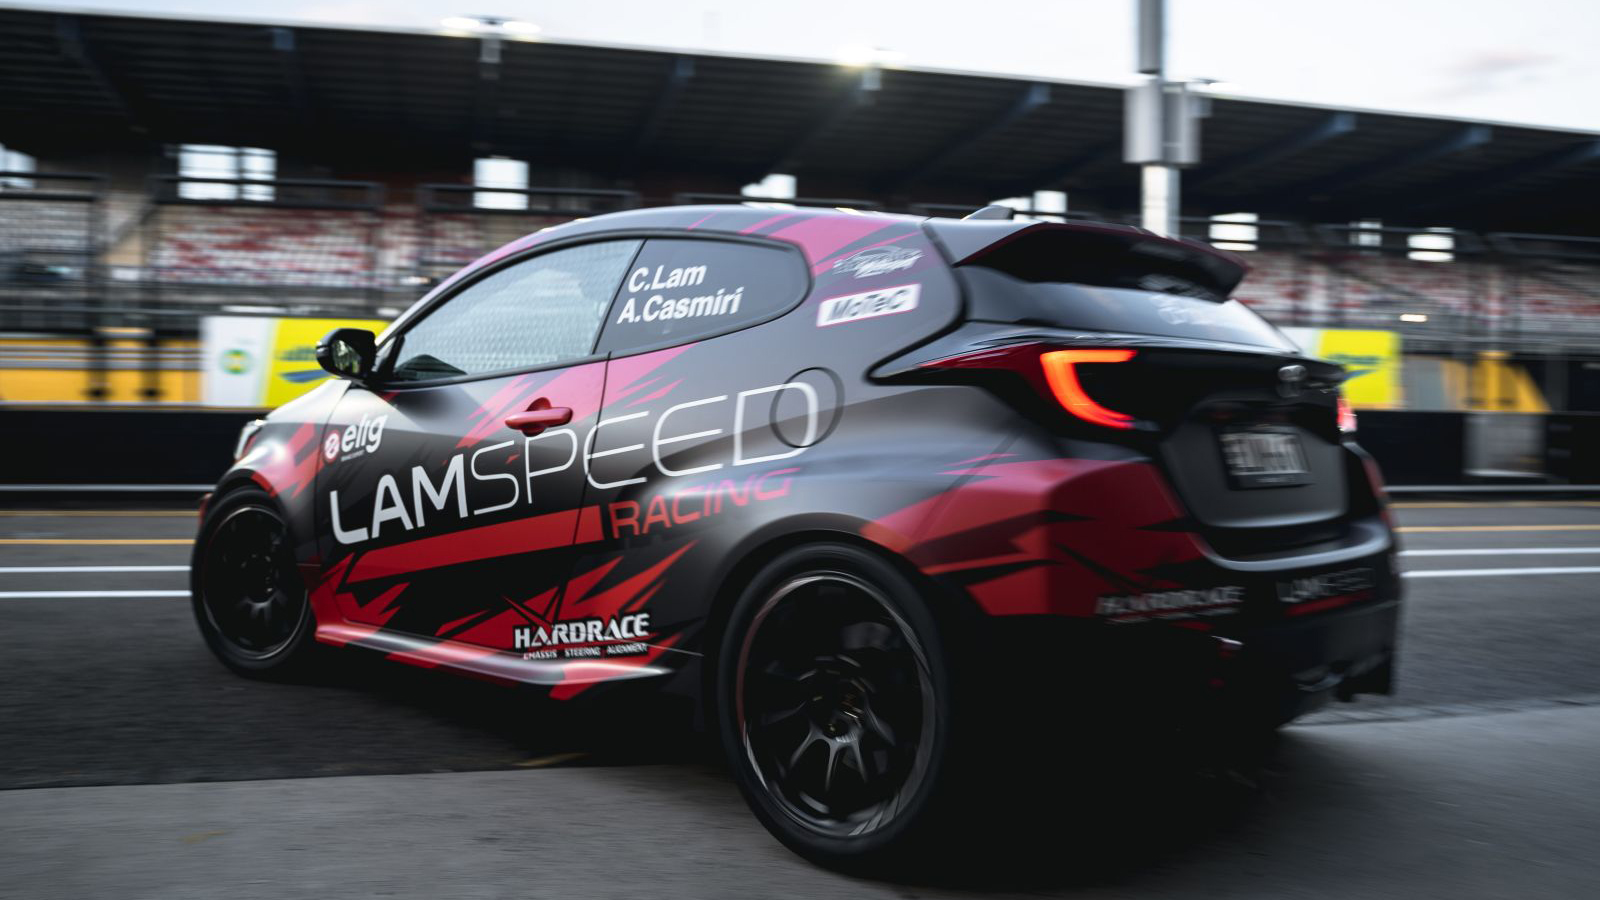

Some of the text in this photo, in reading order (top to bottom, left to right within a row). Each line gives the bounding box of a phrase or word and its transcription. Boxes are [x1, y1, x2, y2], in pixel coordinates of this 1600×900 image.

[628, 264, 707, 293] C.Lam
[616, 286, 745, 324] A.Casmiri
[329, 381, 819, 545] LAMSPEED
[608, 467, 800, 539] RACING
[514, 613, 650, 649] HARDRACE
